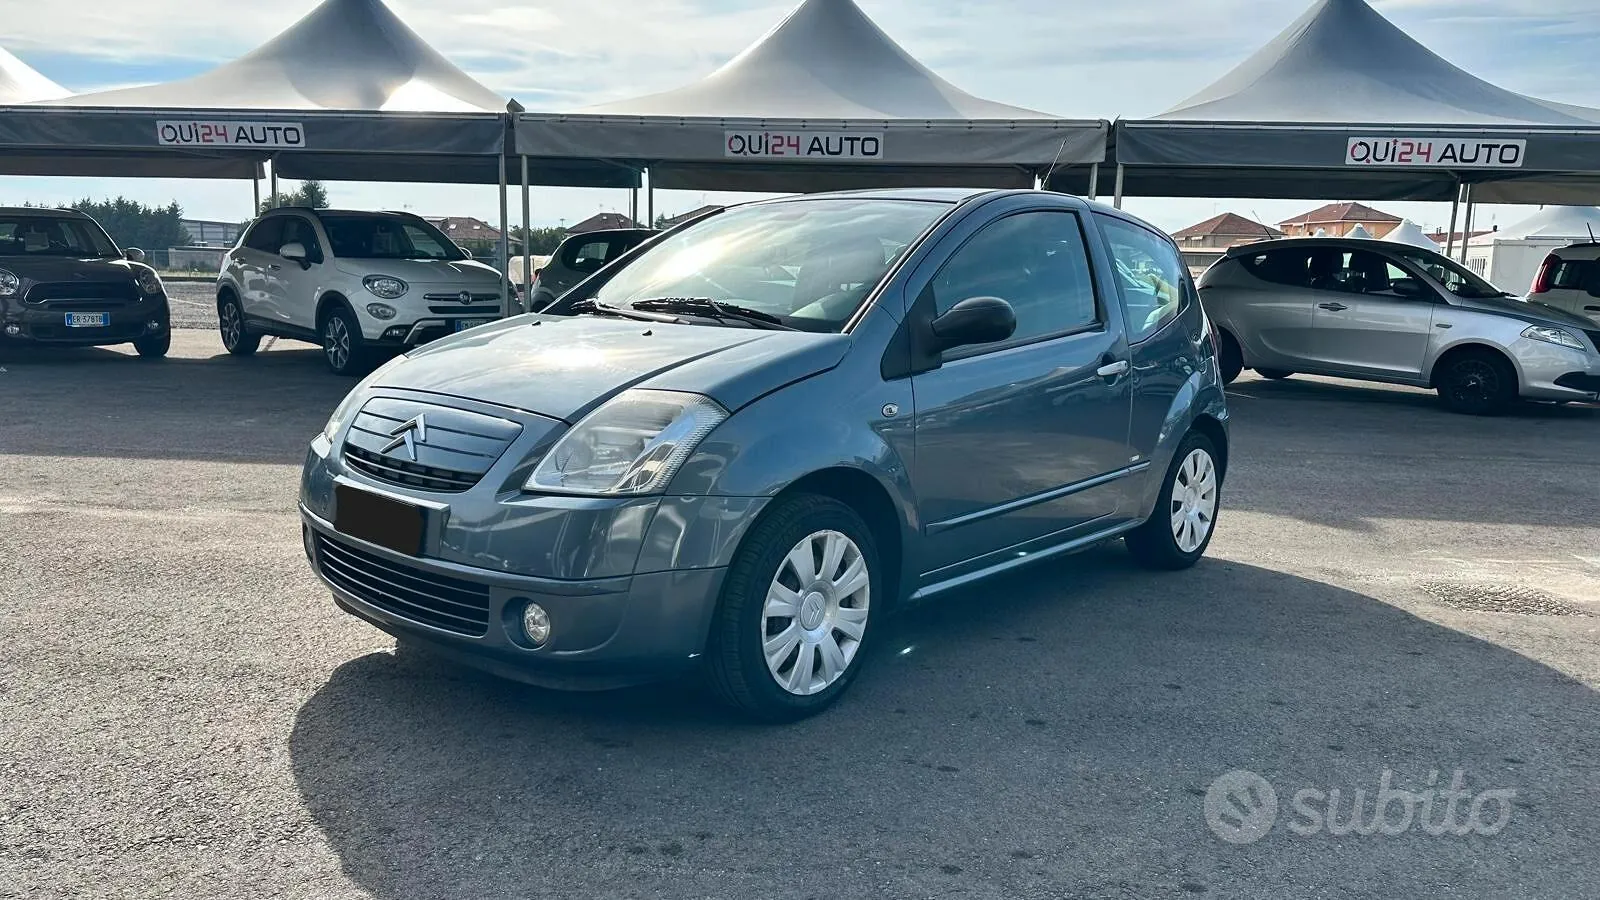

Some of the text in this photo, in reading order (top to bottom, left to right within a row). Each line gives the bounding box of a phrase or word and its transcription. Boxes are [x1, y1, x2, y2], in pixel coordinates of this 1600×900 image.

[234, 126, 301, 145] AUTO
[806, 136, 879, 156] AUTO
[1437, 143, 1520, 164] AUTO
